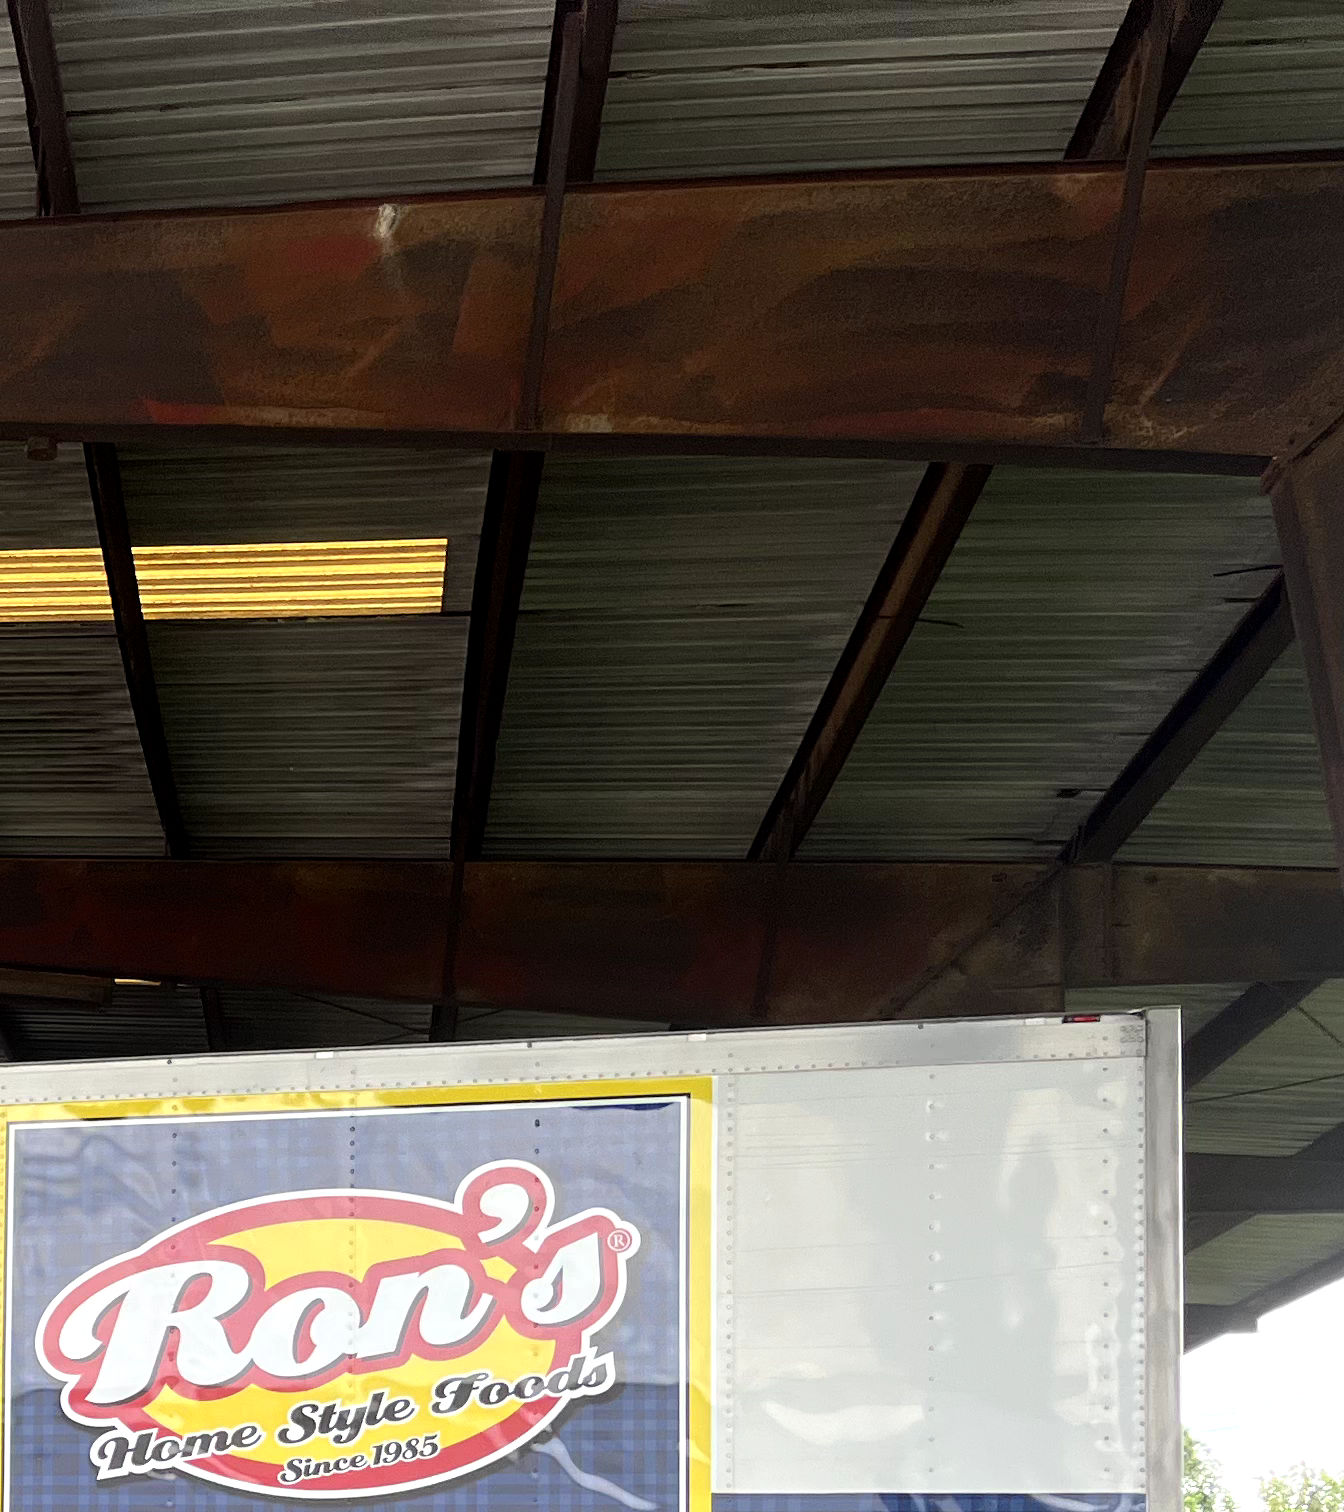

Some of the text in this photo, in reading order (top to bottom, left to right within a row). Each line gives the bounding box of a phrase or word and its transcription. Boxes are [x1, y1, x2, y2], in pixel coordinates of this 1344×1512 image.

[95, 1355, 609, 1474] Home Style Foods
[279, 1434, 440, 1483] Since 1985
